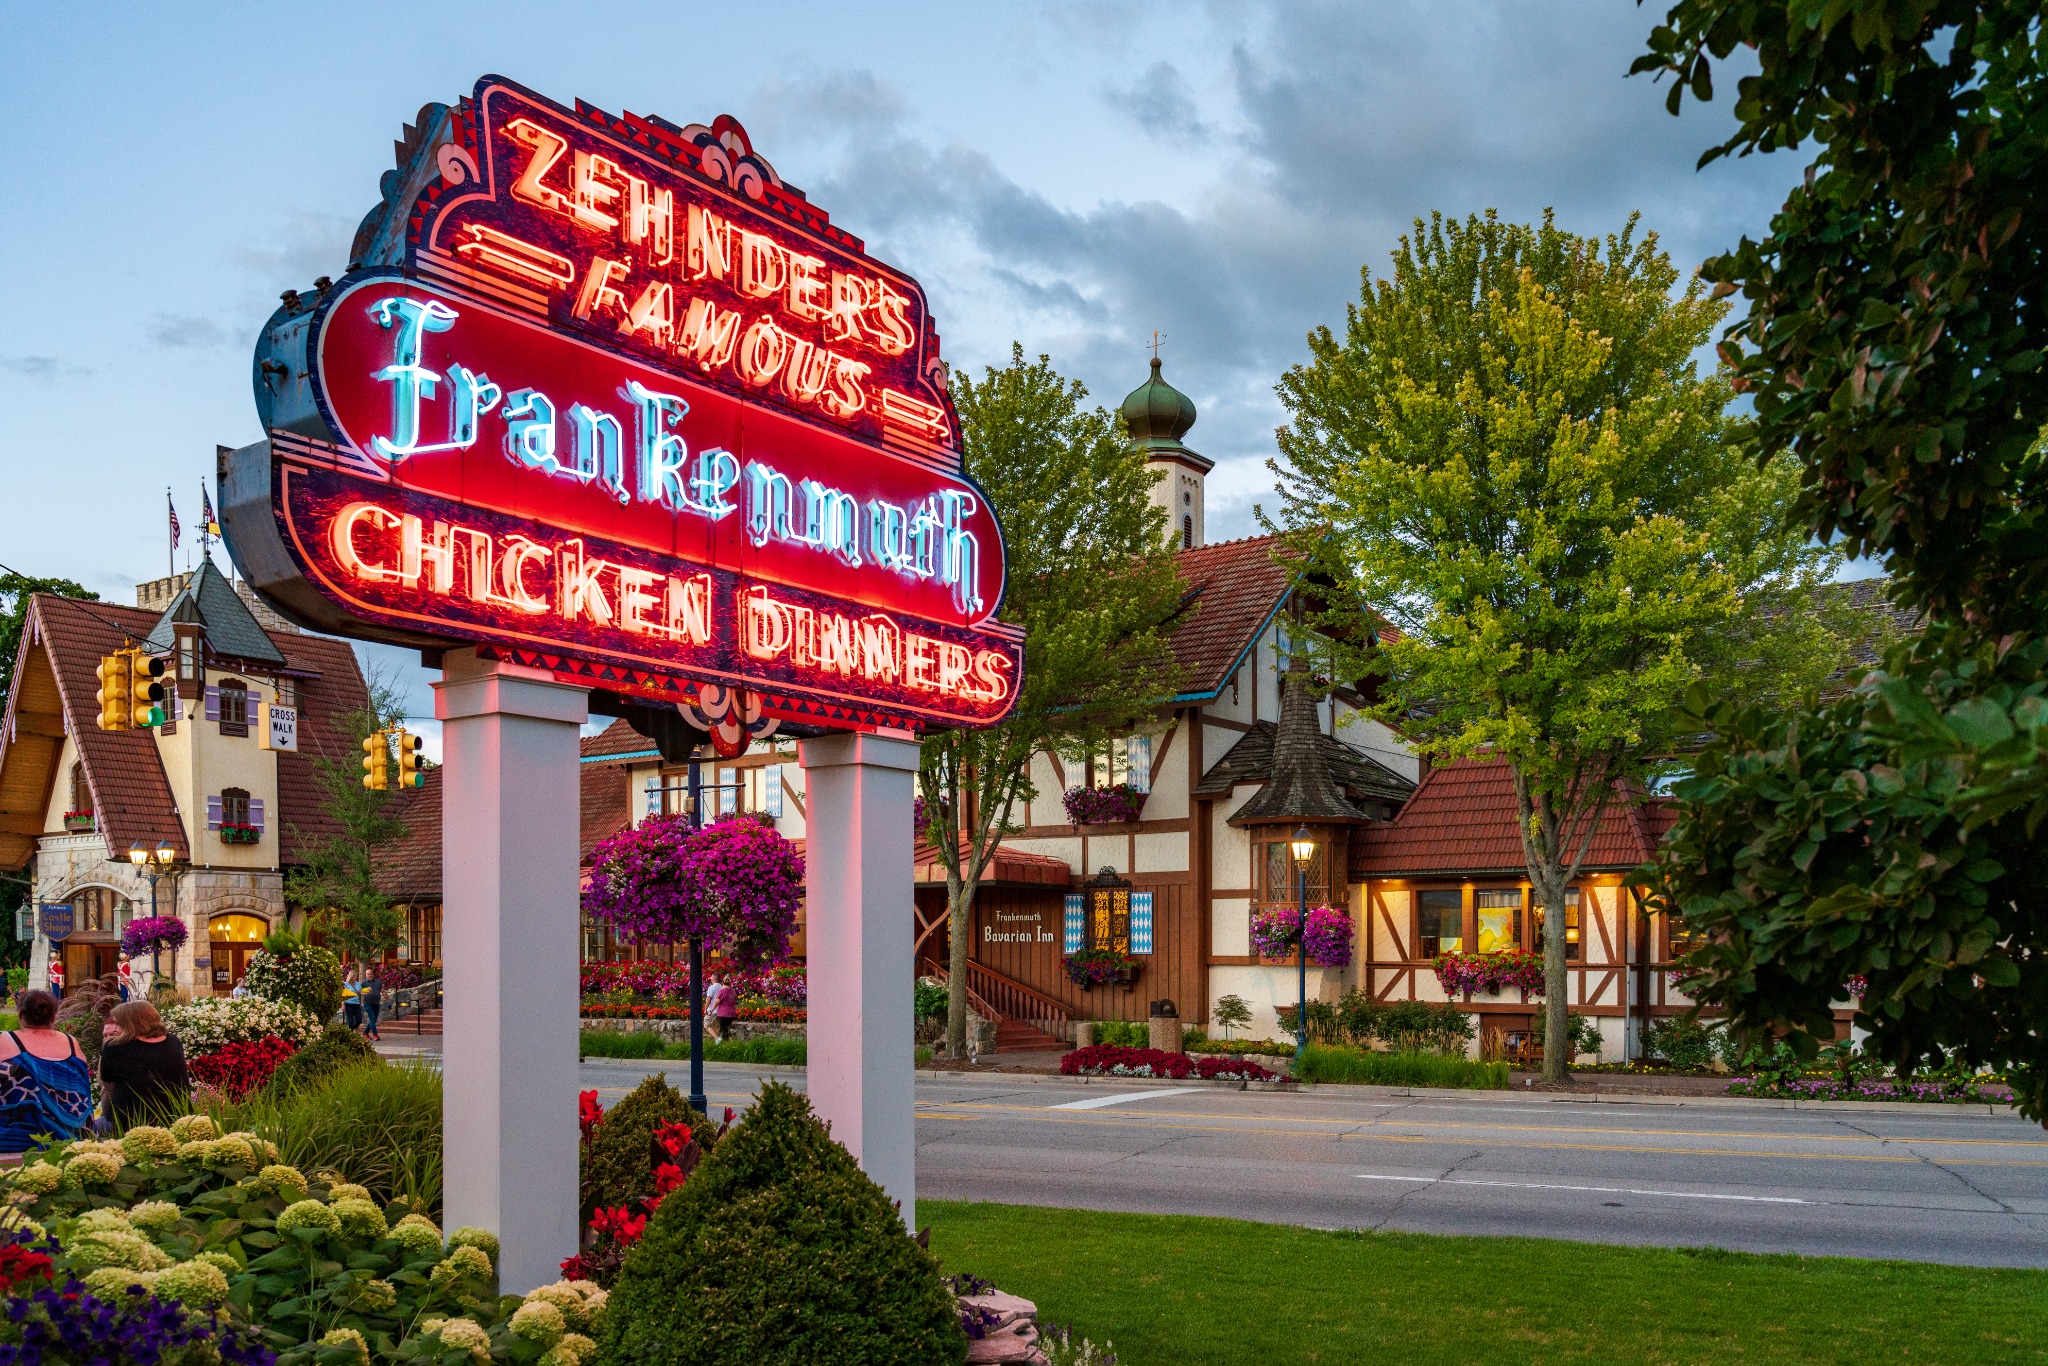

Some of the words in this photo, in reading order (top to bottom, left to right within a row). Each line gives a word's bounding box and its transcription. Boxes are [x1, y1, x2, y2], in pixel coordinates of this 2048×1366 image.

[499, 118, 916, 356] ZEHNDER'S
[572, 255, 872, 418] FAMOUS
[368, 296, 984, 615] Frankenmuth
[328, 502, 712, 647] CHICKEN
[741, 583, 1013, 703] DINNERS
[270, 708, 295, 722] CROSS
[272, 721, 293, 734] WALK
[43, 911, 72, 922] Castle
[995, 910, 1042, 922] Frankenmuth
[43, 922, 71, 934] Shops
[984, 925, 1032, 943] Bavarian
[1036, 925, 1055, 943] Inn
